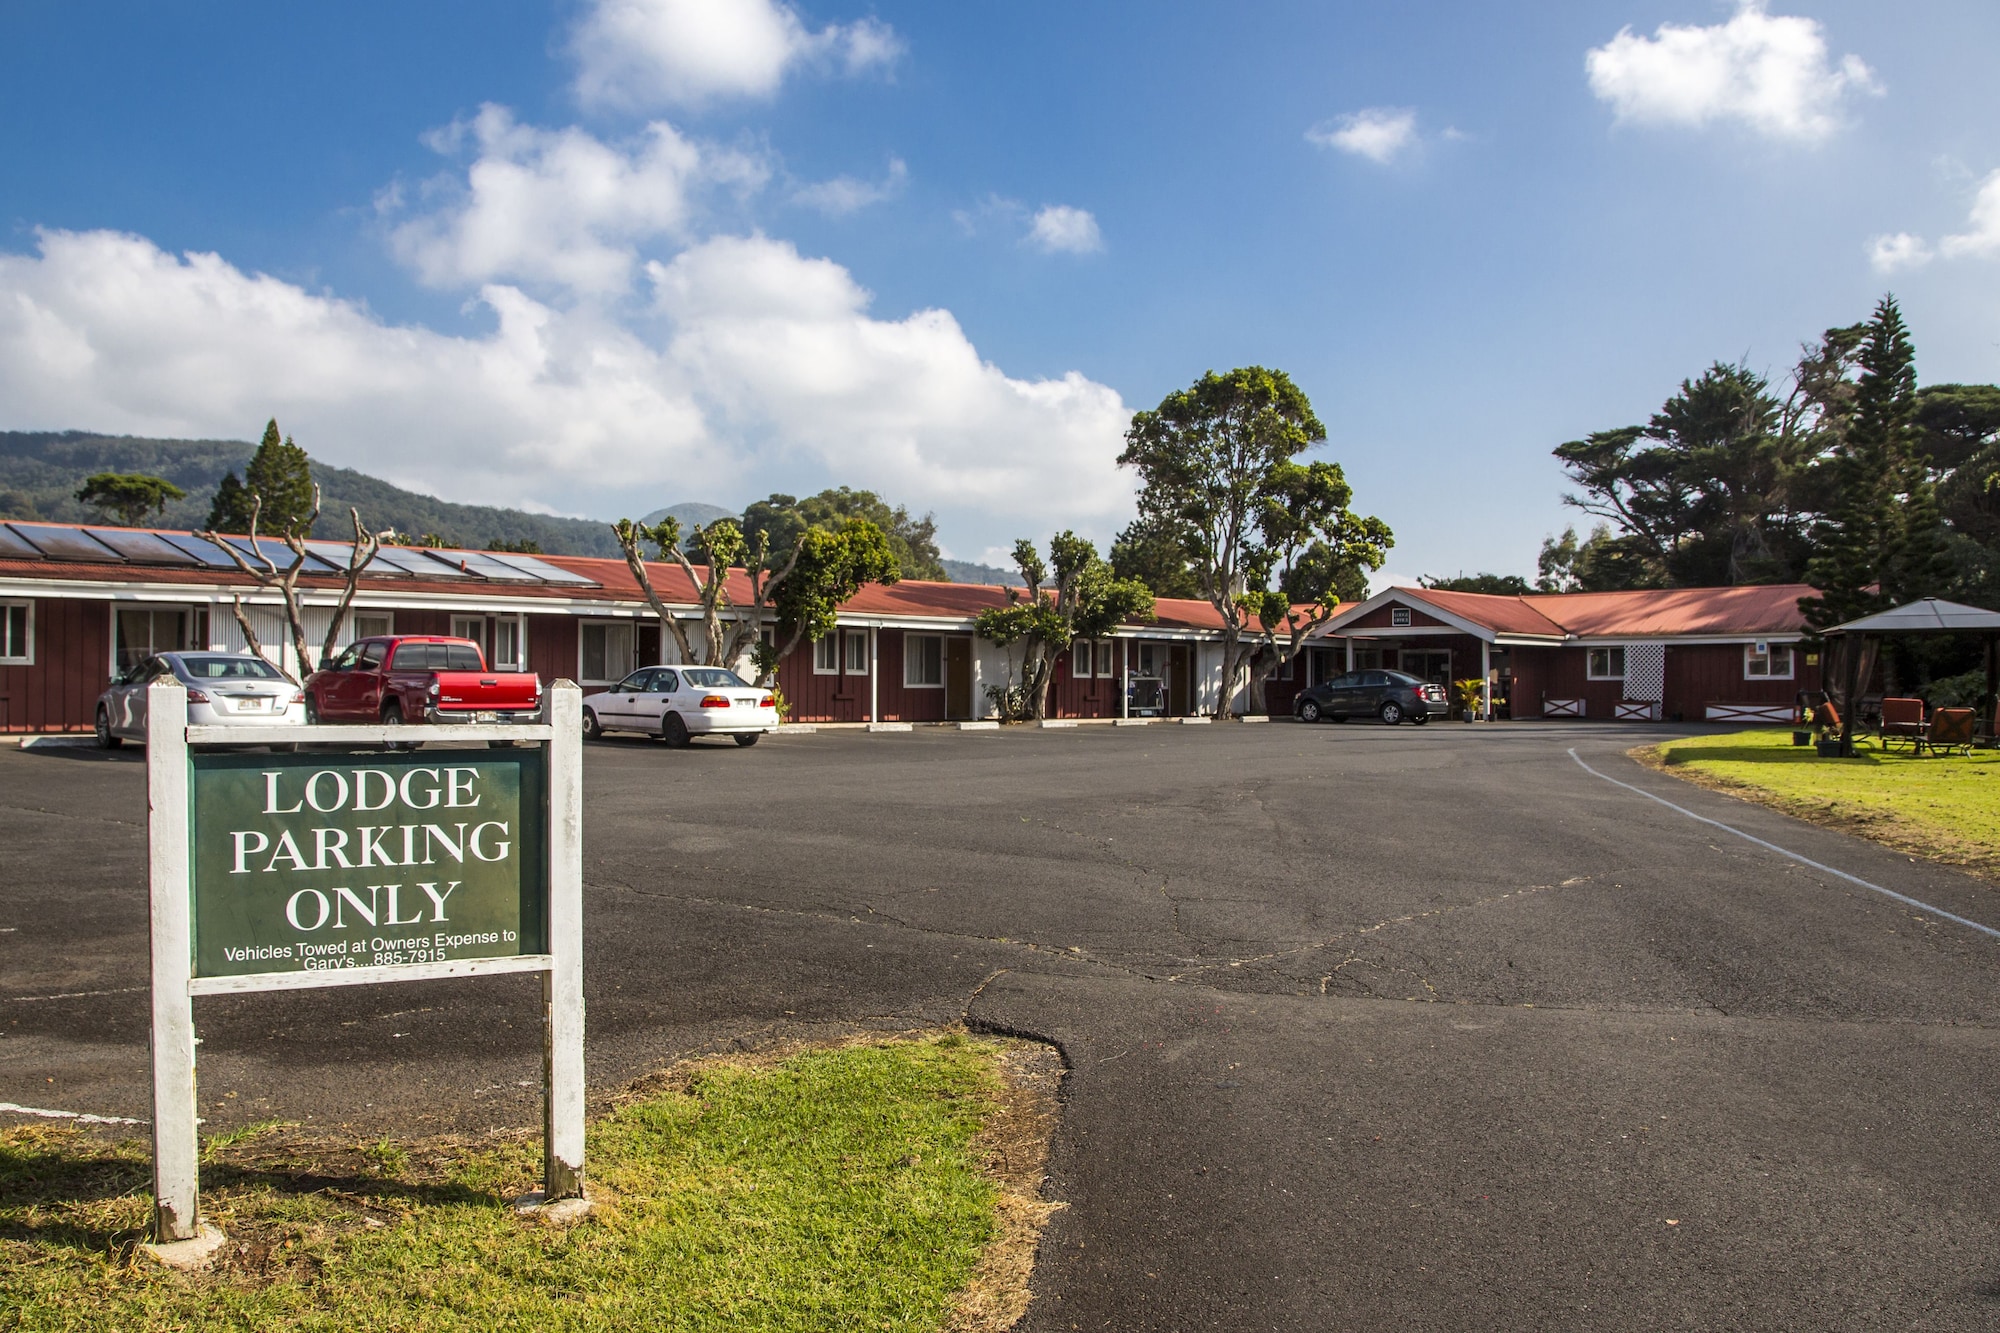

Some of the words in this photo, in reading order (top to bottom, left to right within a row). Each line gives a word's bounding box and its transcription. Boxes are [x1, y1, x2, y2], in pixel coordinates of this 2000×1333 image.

[261, 767, 481, 814] LODGE
[229, 821, 511, 874] PARKING
[285, 881, 462, 931] ONLY
[224, 944, 292, 962] Vehicles
[295, 939, 347, 957] Towed
[351, 937, 367, 953] at
[371, 935, 430, 951] Owners
[434, 931, 499, 947] Expense
[503, 929, 517, 942] to
